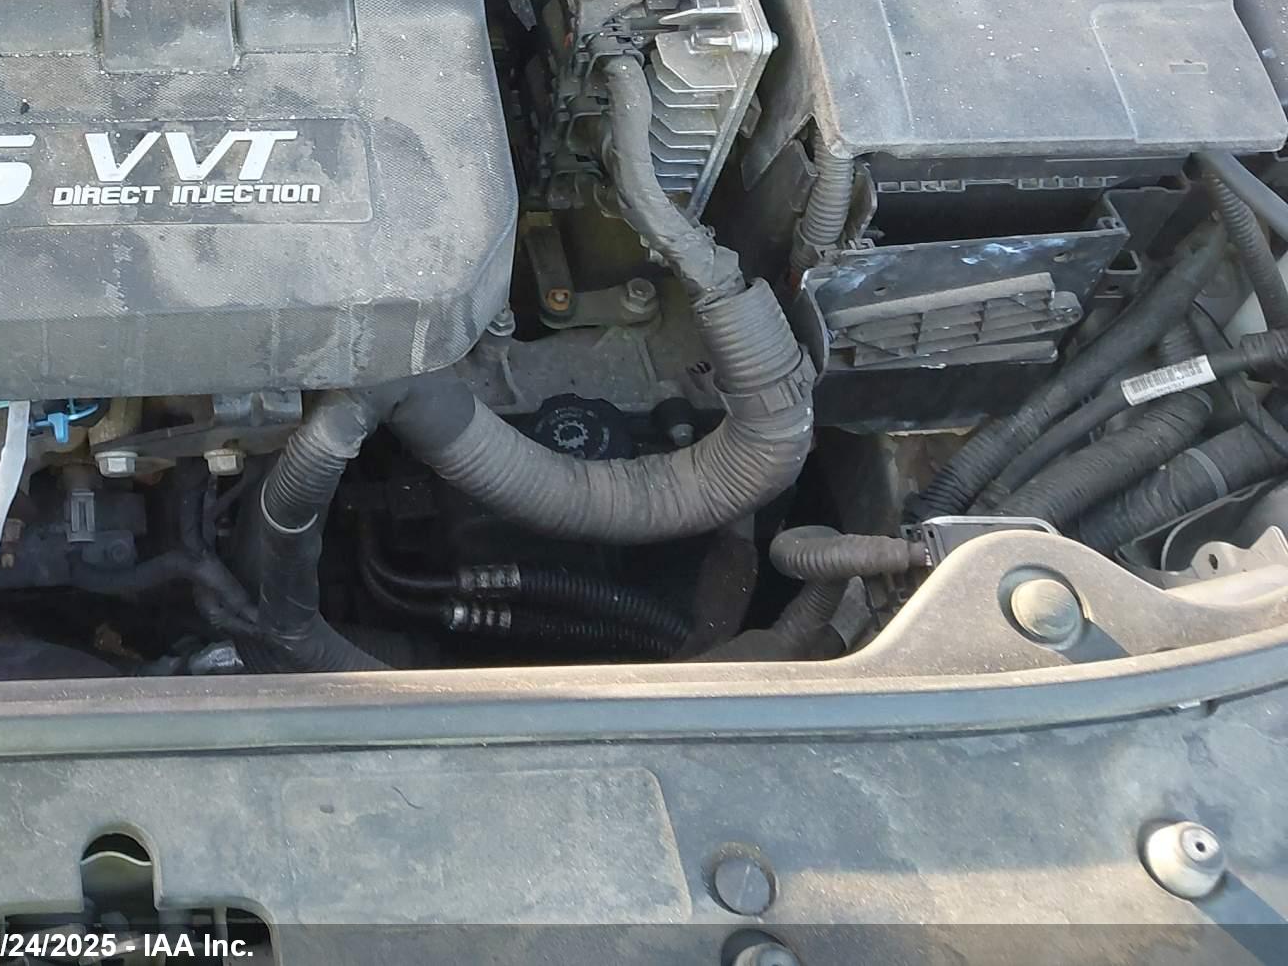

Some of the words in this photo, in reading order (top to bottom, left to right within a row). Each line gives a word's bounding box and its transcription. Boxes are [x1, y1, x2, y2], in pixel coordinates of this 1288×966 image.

[85, 130, 298, 183] VVT
[52, 185, 160, 206] DIRECT
[171, 183, 321, 205] INJECTION
